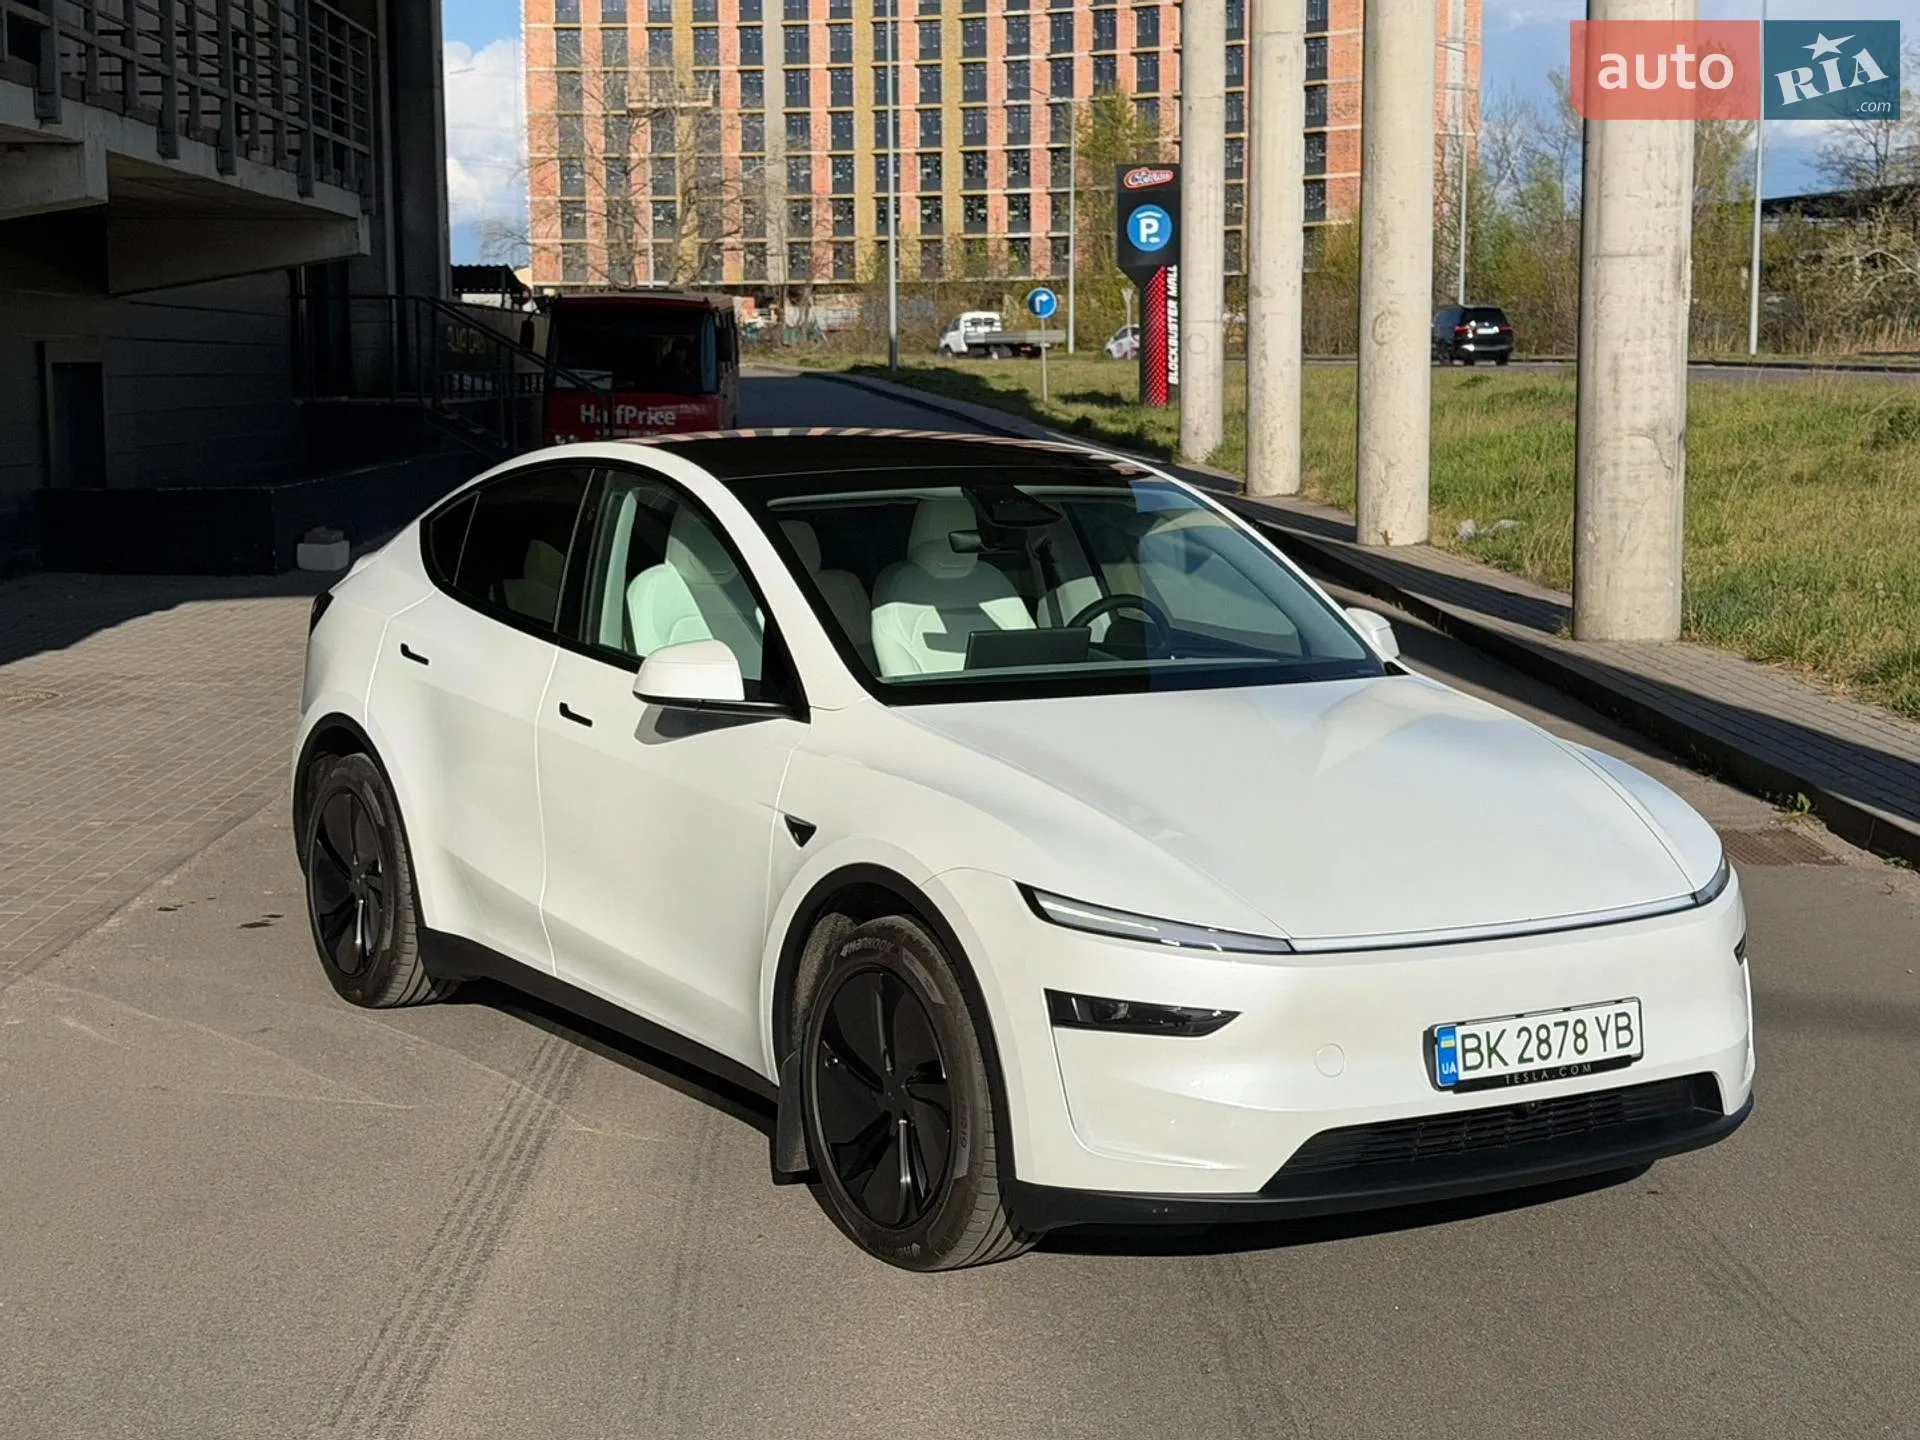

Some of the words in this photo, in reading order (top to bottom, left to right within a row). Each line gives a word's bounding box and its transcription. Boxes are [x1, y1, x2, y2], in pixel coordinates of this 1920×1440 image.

[1167, 264, 1178, 297] MALL
[1167, 299, 1179, 385] BLOCKBUSTER
[579, 403, 677, 427] HafPrice
[1461, 1028, 1509, 1072] BK
[1516, 1018, 1589, 1065] 2878
[1594, 1011, 1634, 1051] YB
[1441, 1061, 1457, 1075] UA
[1504, 1063, 1592, 1085] TESLA.COM
